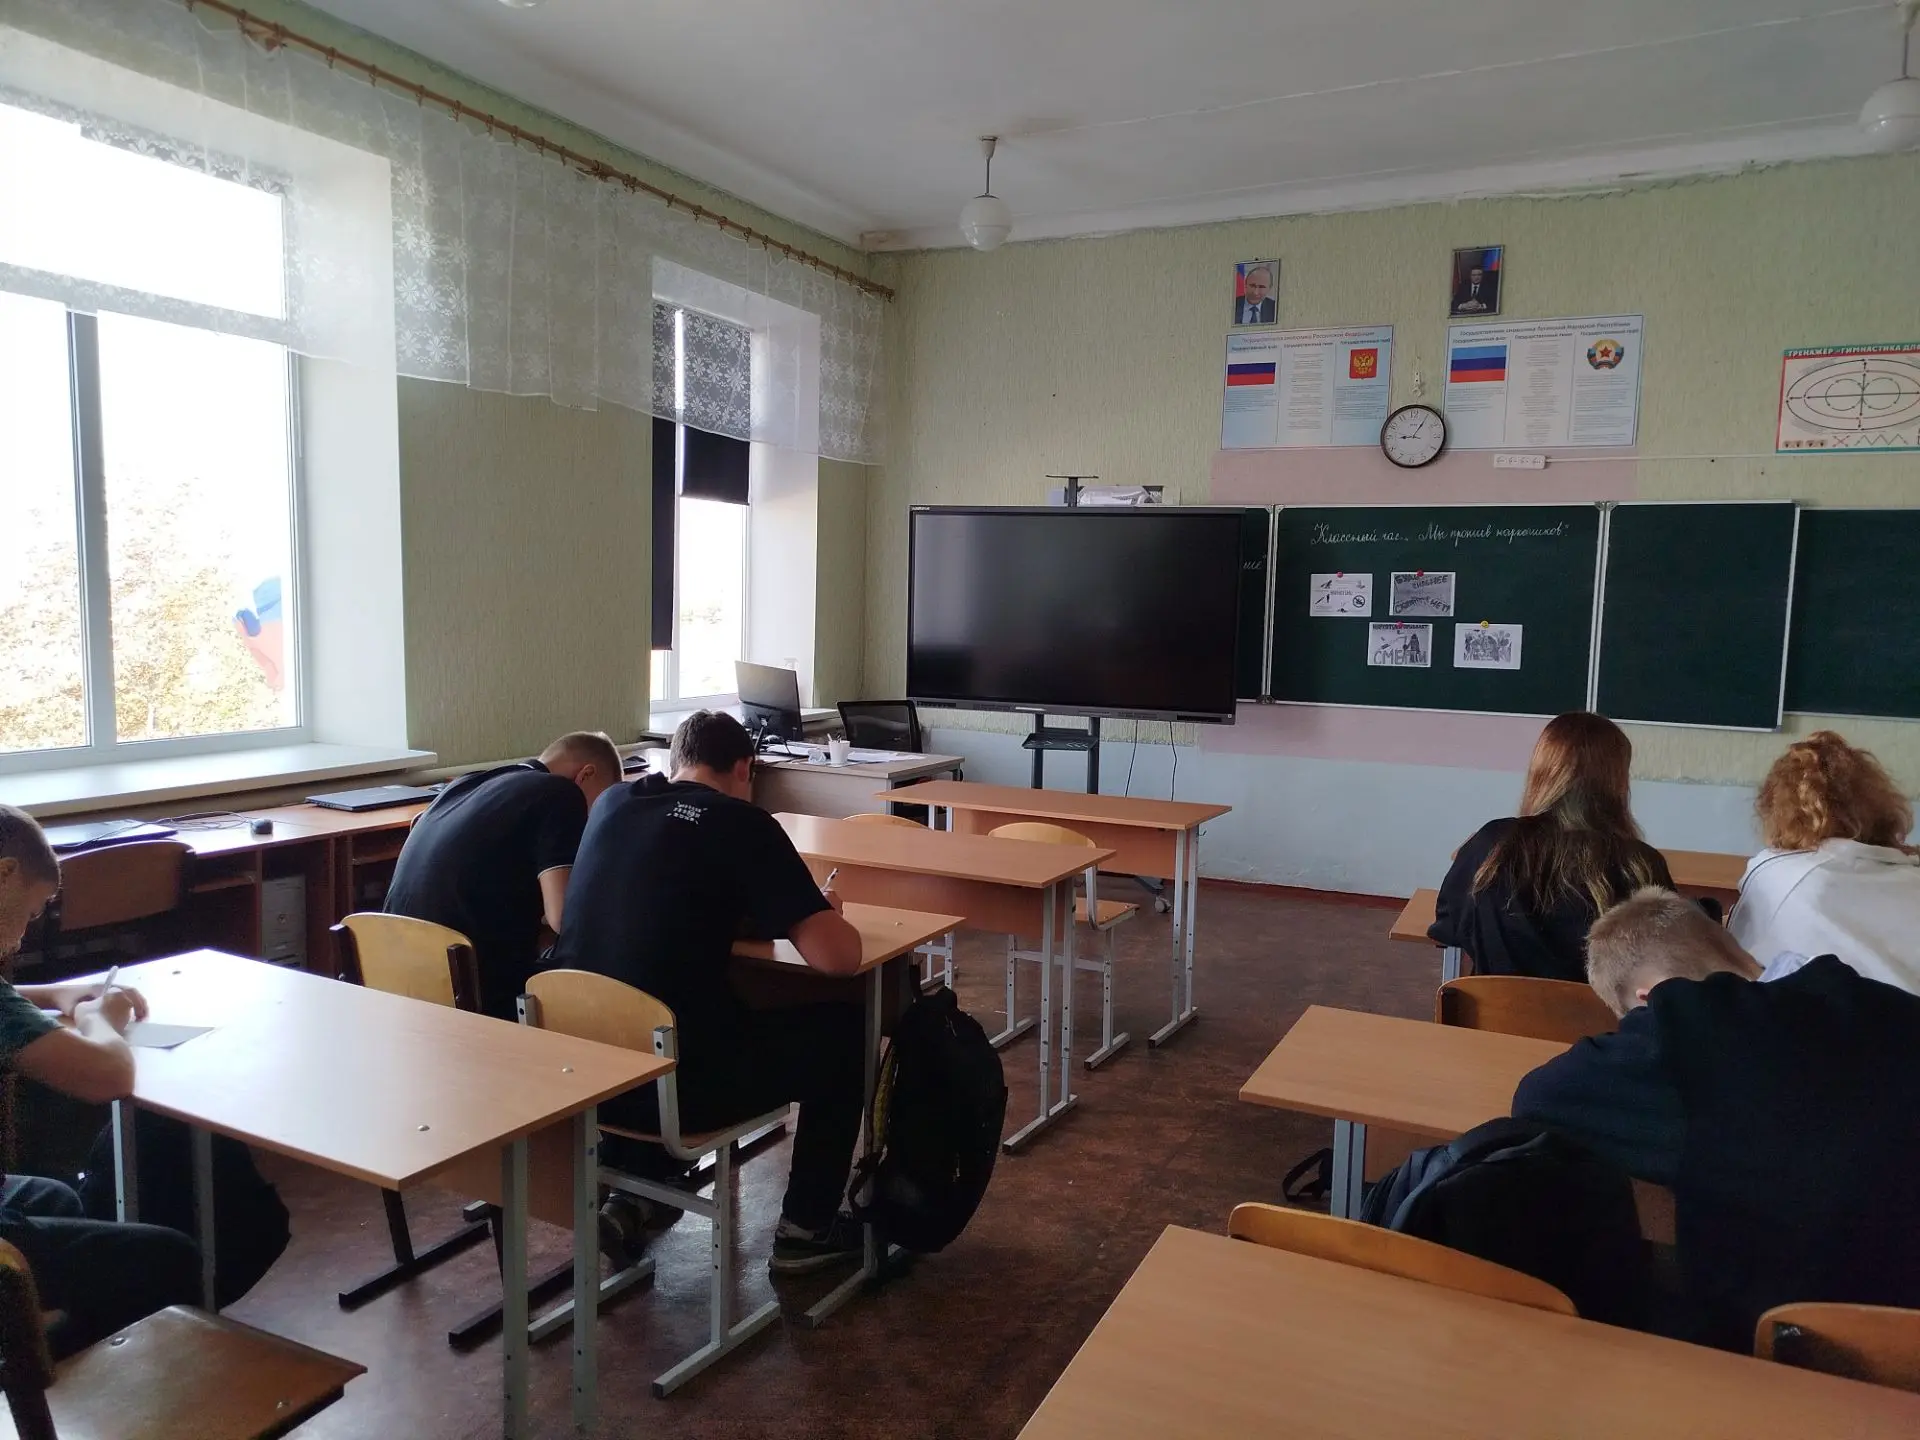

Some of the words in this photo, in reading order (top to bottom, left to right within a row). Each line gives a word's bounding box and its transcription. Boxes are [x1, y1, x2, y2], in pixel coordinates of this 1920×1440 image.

[1841, 344, 1901, 354] ГИМНАСТИКА
[1410, 409, 1419, 420] 12
[1311, 522, 1378, 546] Классный
[1450, 523, 1493, 547] против
